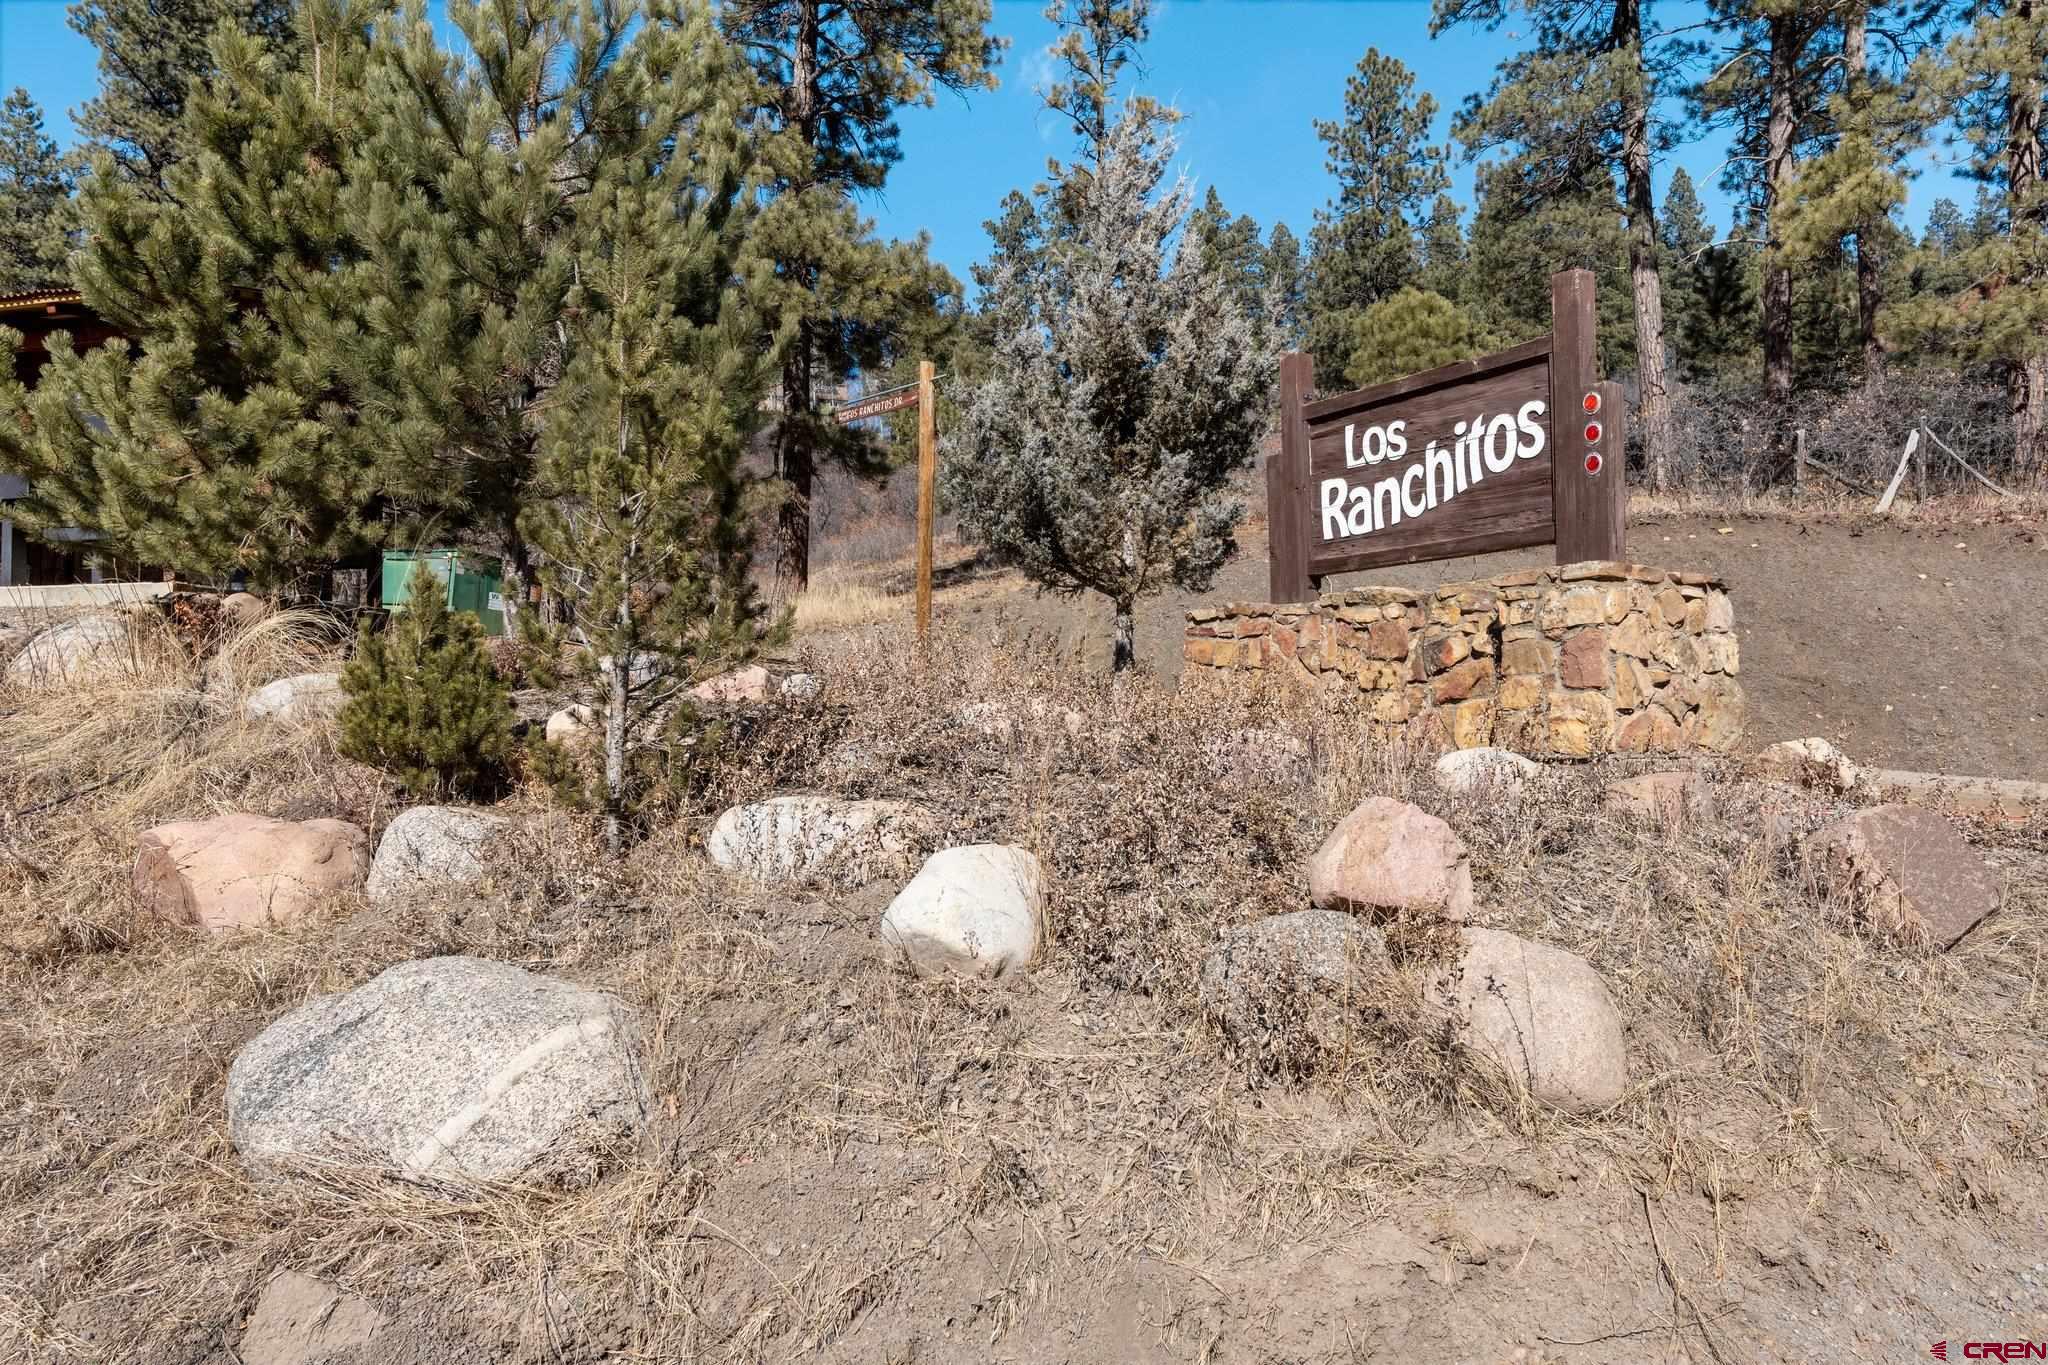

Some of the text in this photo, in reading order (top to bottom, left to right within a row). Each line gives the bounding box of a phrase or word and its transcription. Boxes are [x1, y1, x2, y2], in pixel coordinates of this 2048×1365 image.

[859, 399, 893, 416] RANCHITOS
[894, 396, 903, 407] DR
[1345, 420, 1408, 468] Los
[1321, 400, 1546, 541] Ranchitos
